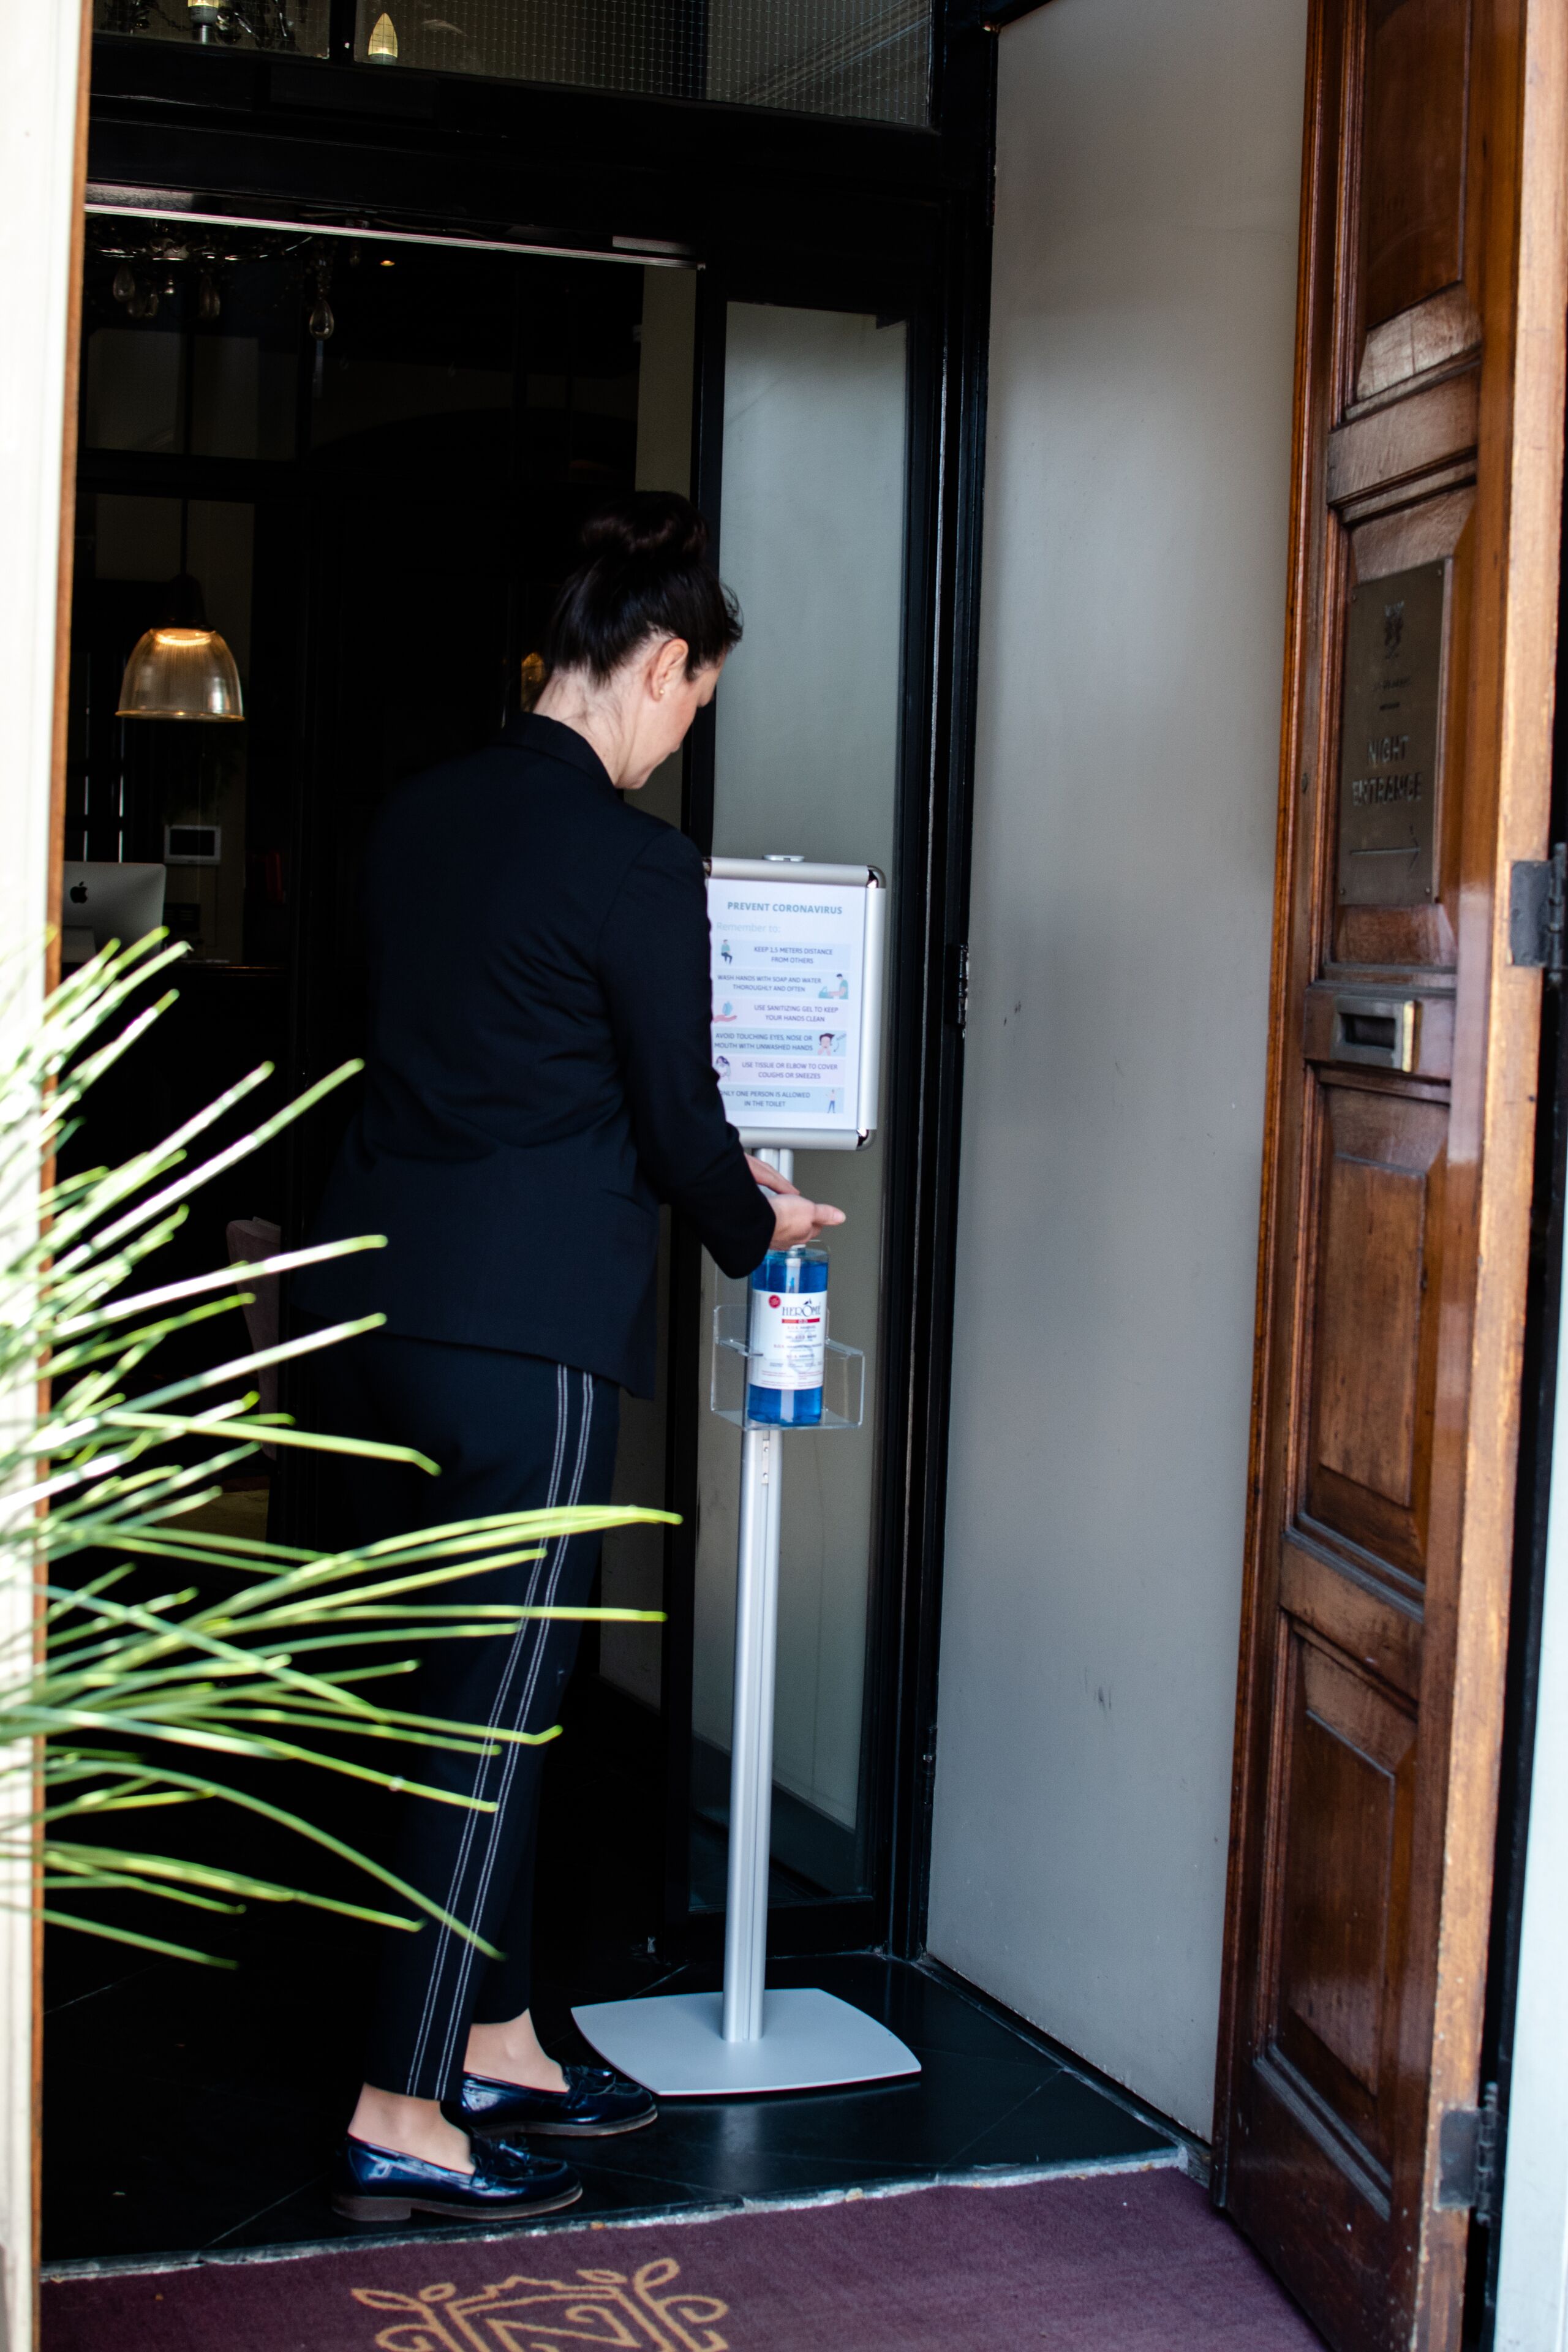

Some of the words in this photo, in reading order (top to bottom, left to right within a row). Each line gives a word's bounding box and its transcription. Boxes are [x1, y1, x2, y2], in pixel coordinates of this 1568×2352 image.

[1367, 734, 1409, 765] NIGHT
[1352, 771, 1422, 807] ENTRANCE
[728, 902, 770, 911] PREVENT
[772, 903, 843, 914] CORONAVIRUS
[717, 922, 765, 931] Remember
